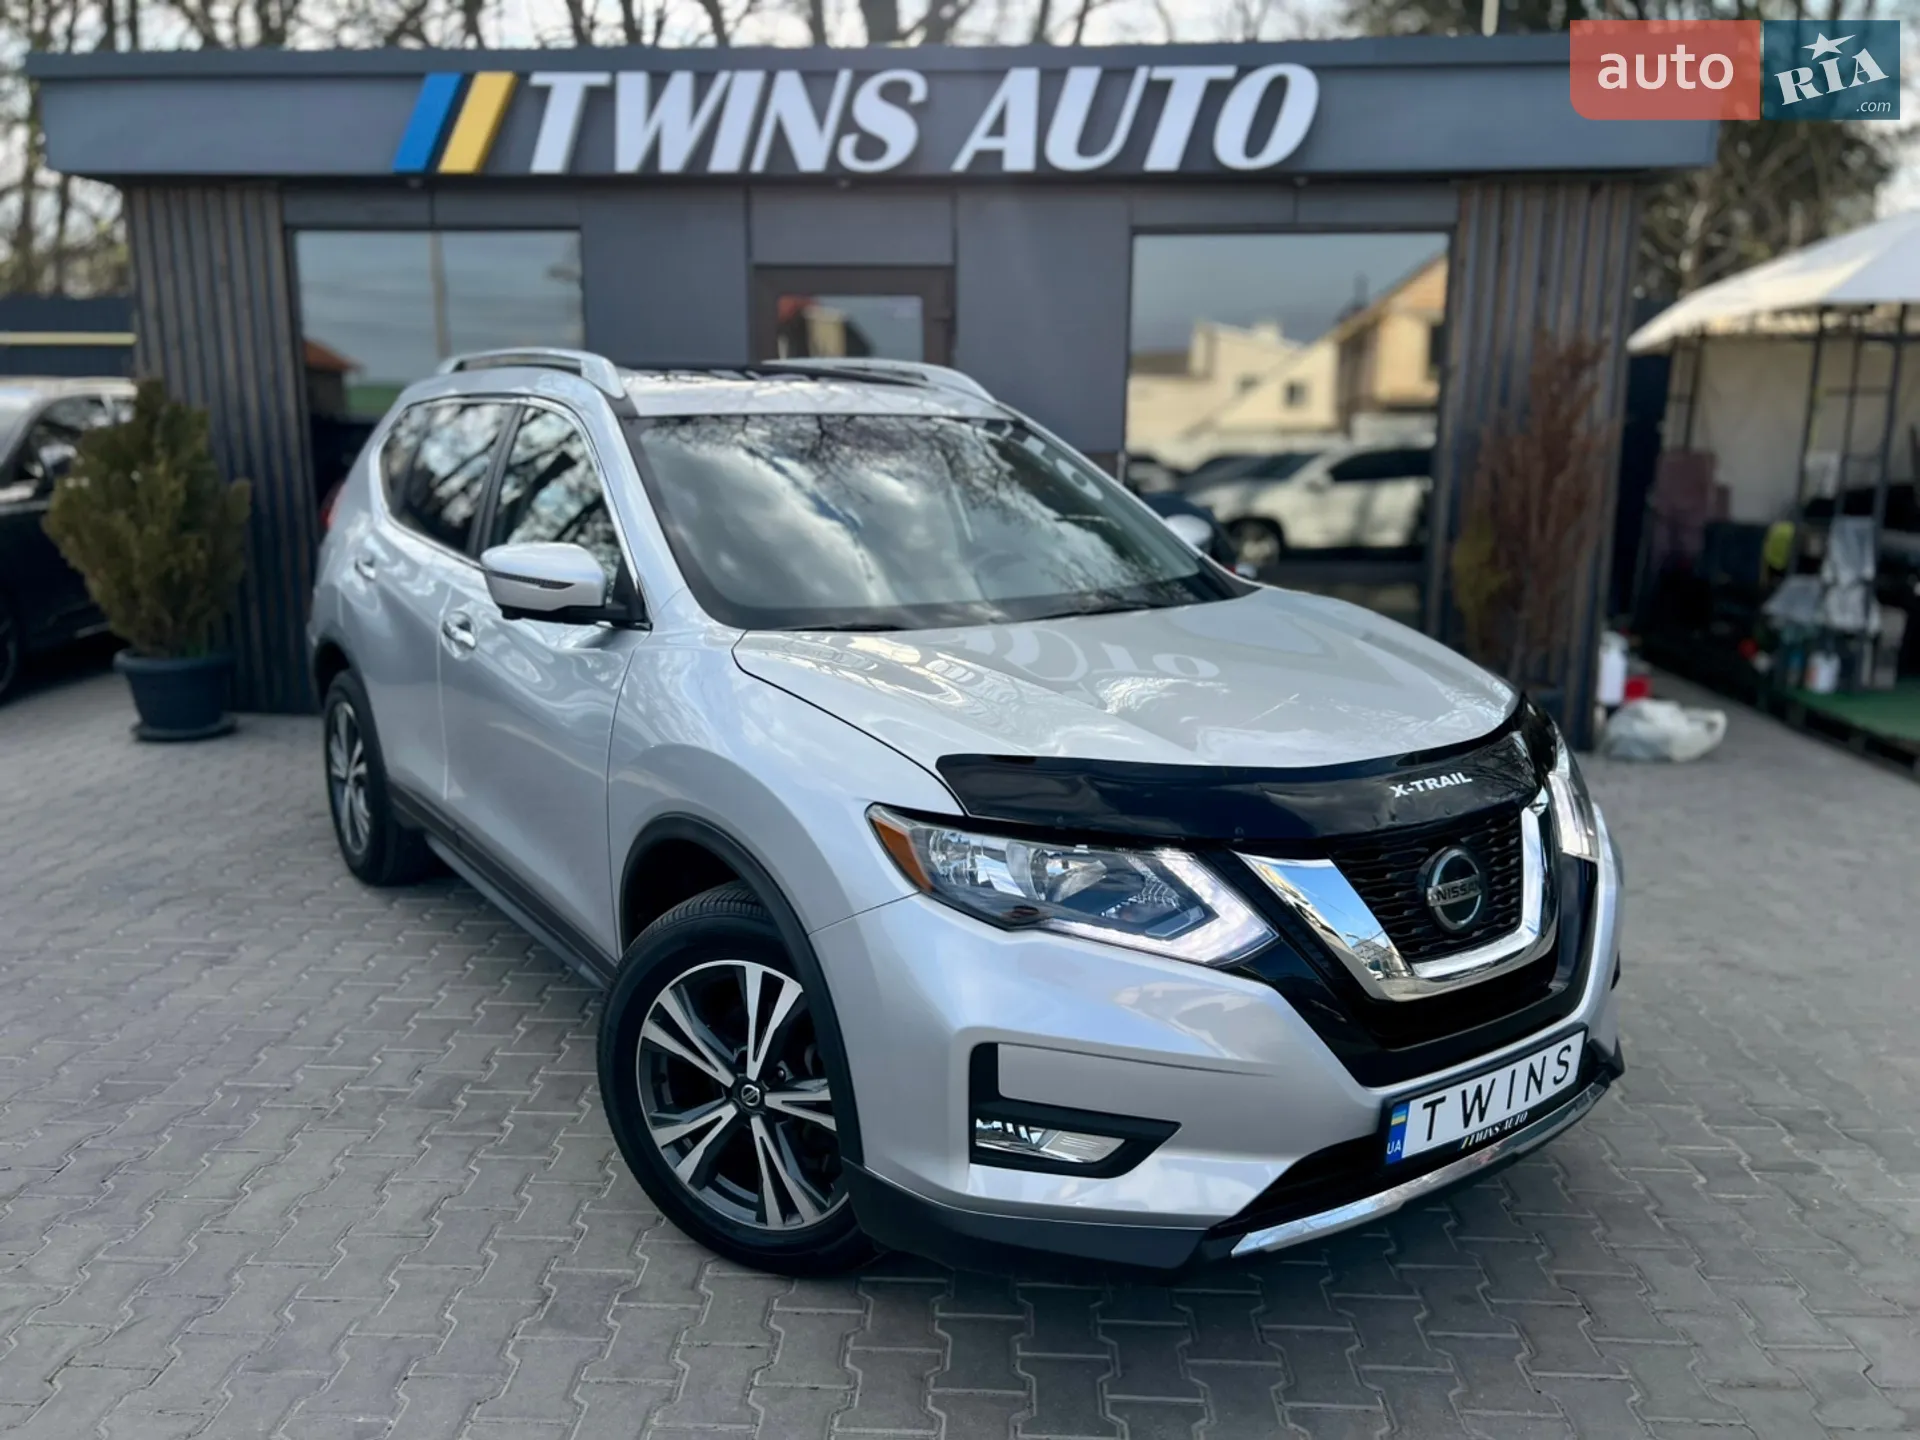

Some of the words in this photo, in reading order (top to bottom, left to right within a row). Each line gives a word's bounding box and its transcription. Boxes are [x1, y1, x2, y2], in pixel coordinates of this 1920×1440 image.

[529, 69, 926, 173] TWINS
[952, 63, 1319, 171] AUTO
[1389, 771, 1473, 798] X-TRAIL
[1422, 1044, 1572, 1141] TWINS
[1386, 1140, 1402, 1155] UA
